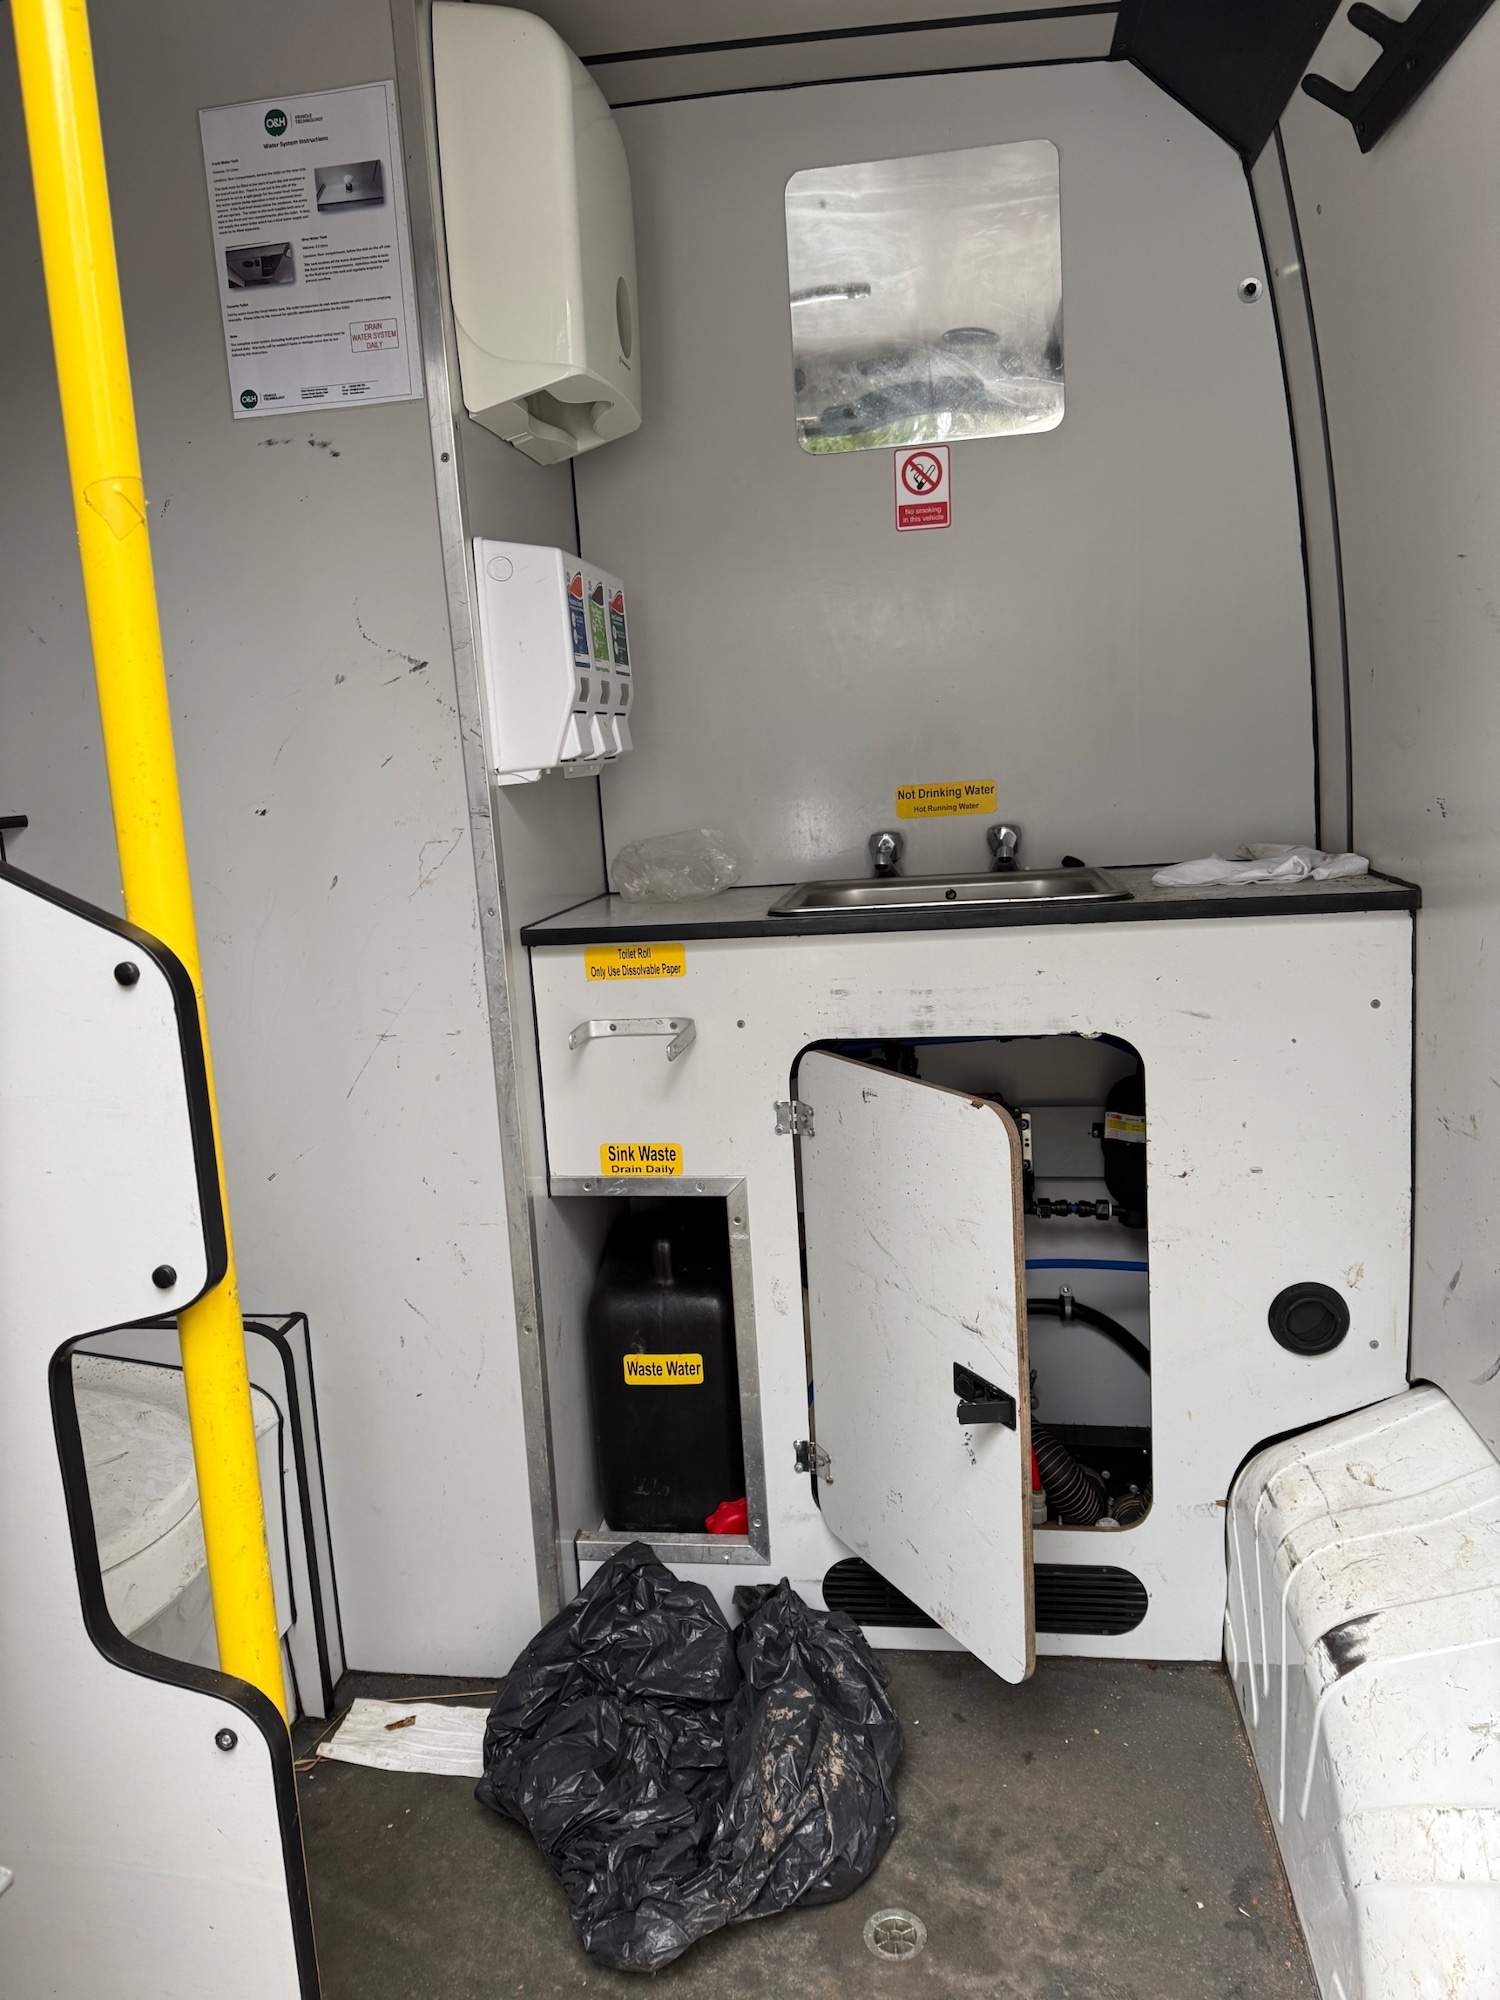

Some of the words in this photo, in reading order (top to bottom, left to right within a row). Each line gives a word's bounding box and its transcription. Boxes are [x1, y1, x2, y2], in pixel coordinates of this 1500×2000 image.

[266, 117, 286, 129] O&H
[295, 116, 323, 124] TECHNOLOGY
[263, 141, 279, 149] Water
[280, 139, 298, 149] System
[299, 136, 329, 145] Instructions
[364, 323, 382, 331] DRAIN
[352, 333, 372, 342] WATER
[373, 330, 396, 340] SYSTEM
[367, 341, 383, 349] DAILY
[915, 506, 942, 514] smoking
[922, 513, 944, 522] vehicle
[898, 789, 916, 800] Not
[918, 787, 962, 799] Drinking
[964, 785, 995, 796] Water
[927, 804, 957, 812] Running
[617, 948, 637, 960] Toilet
[638, 947, 651, 959] Roll
[590, 966, 606, 980] Only
[608, 965, 621, 977] Use
[622, 964, 660, 976] Dissolvable
[662, 963, 681, 977] Paper
[608, 1145, 636, 1162] Sink
[638, 1145, 676, 1162] Waste
[612, 1165, 642, 1173] Drain
[646, 1165, 675, 1174] Daily
[626, 1361, 663, 1376] Waste
[666, 1361, 701, 1376] Water
